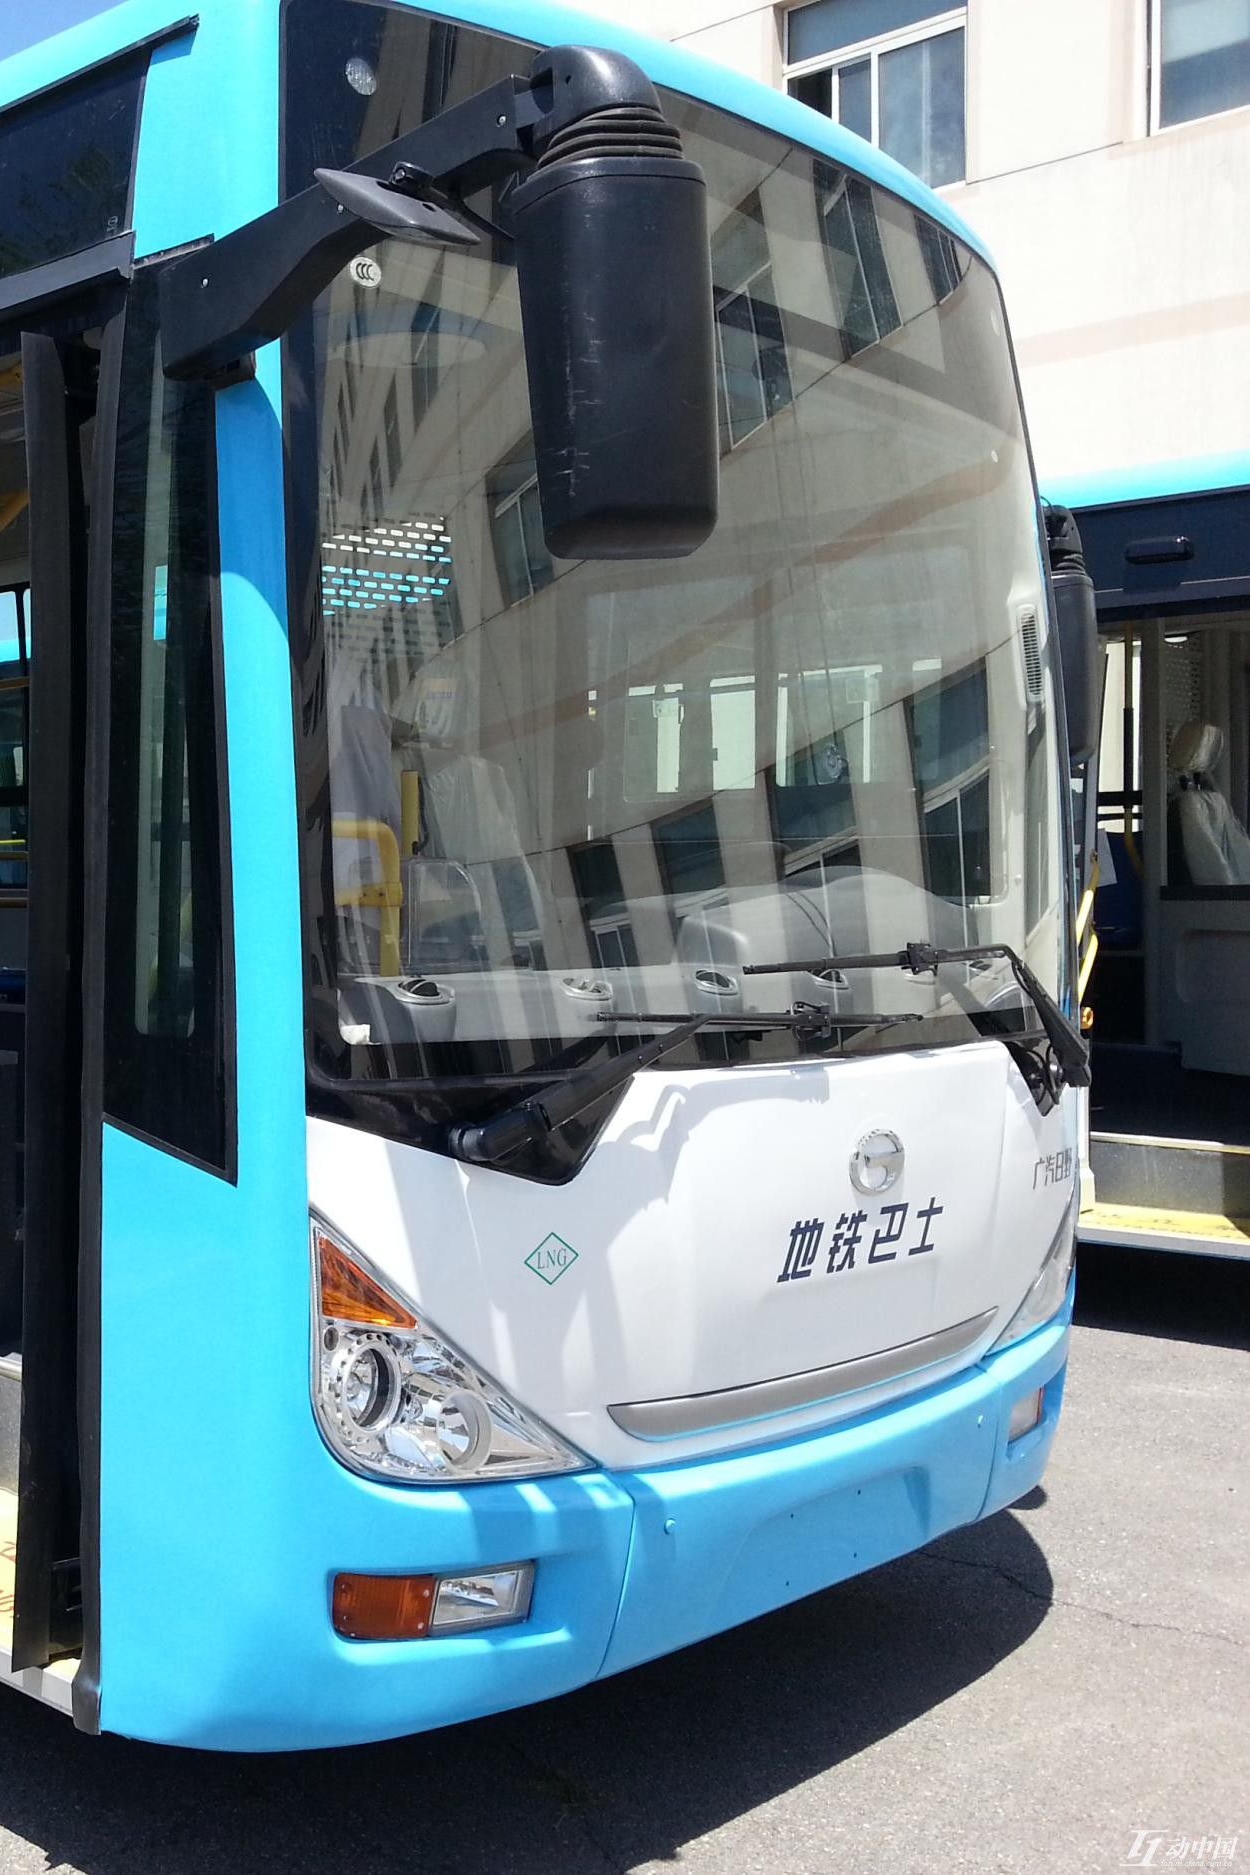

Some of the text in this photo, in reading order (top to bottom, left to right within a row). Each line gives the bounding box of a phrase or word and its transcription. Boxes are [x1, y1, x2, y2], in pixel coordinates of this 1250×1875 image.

[537, 1248, 567, 1270] LNG
[776, 1196, 944, 1283] 地铁巴士
